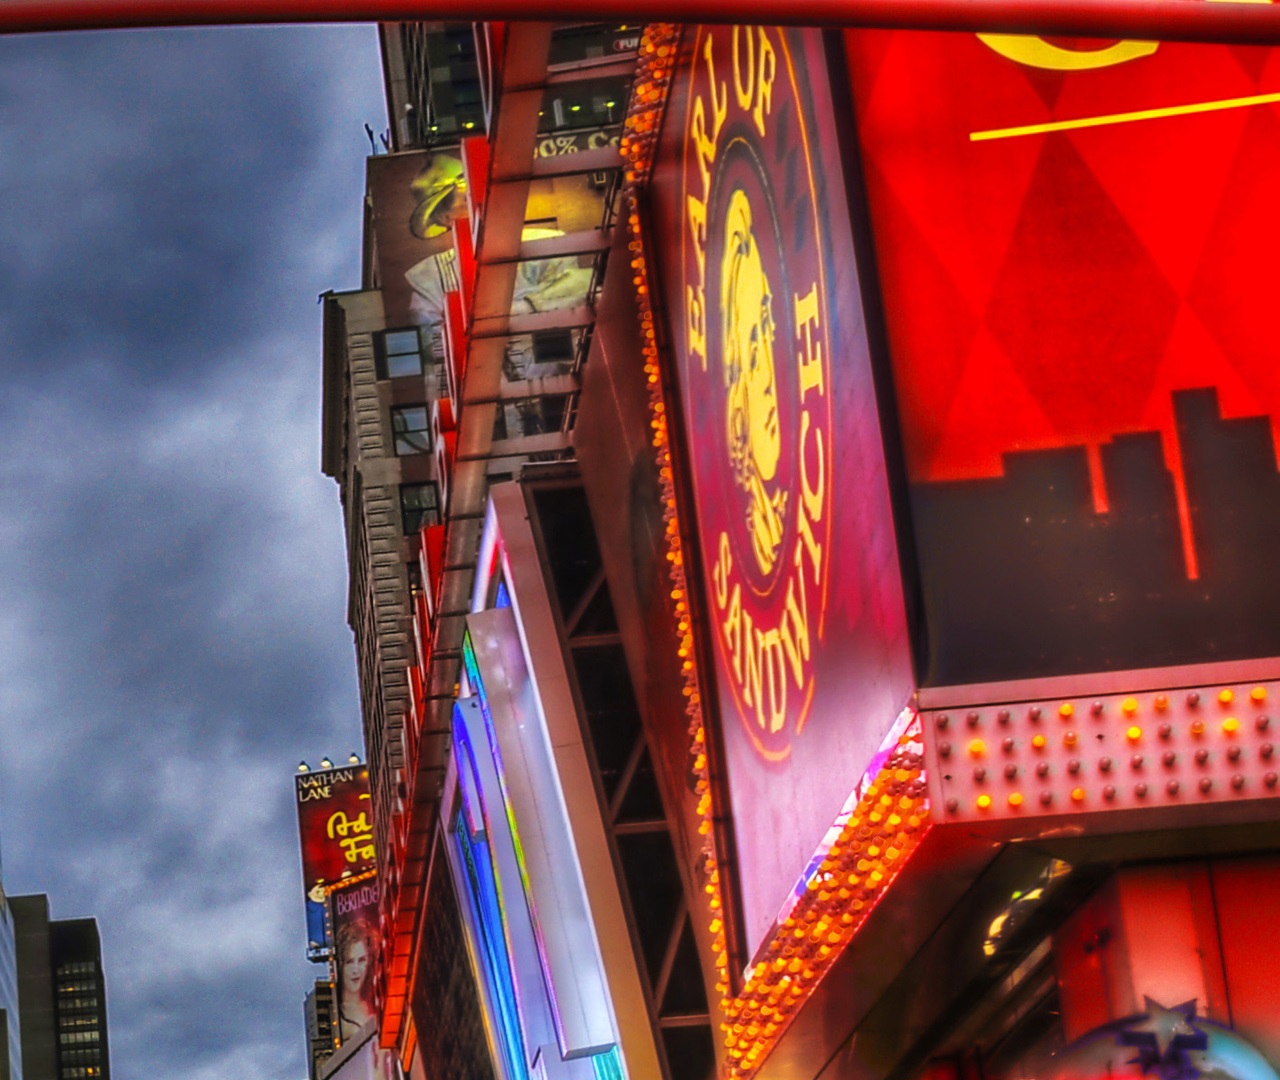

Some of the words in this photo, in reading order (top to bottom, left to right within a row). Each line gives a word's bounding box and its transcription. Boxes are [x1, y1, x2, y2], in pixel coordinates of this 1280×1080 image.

[687, 34, 727, 371] EARL
[711, 283, 826, 734] SANDWICH
[298, 769, 354, 788] NATHAN
[299, 785, 332, 802] LANE
